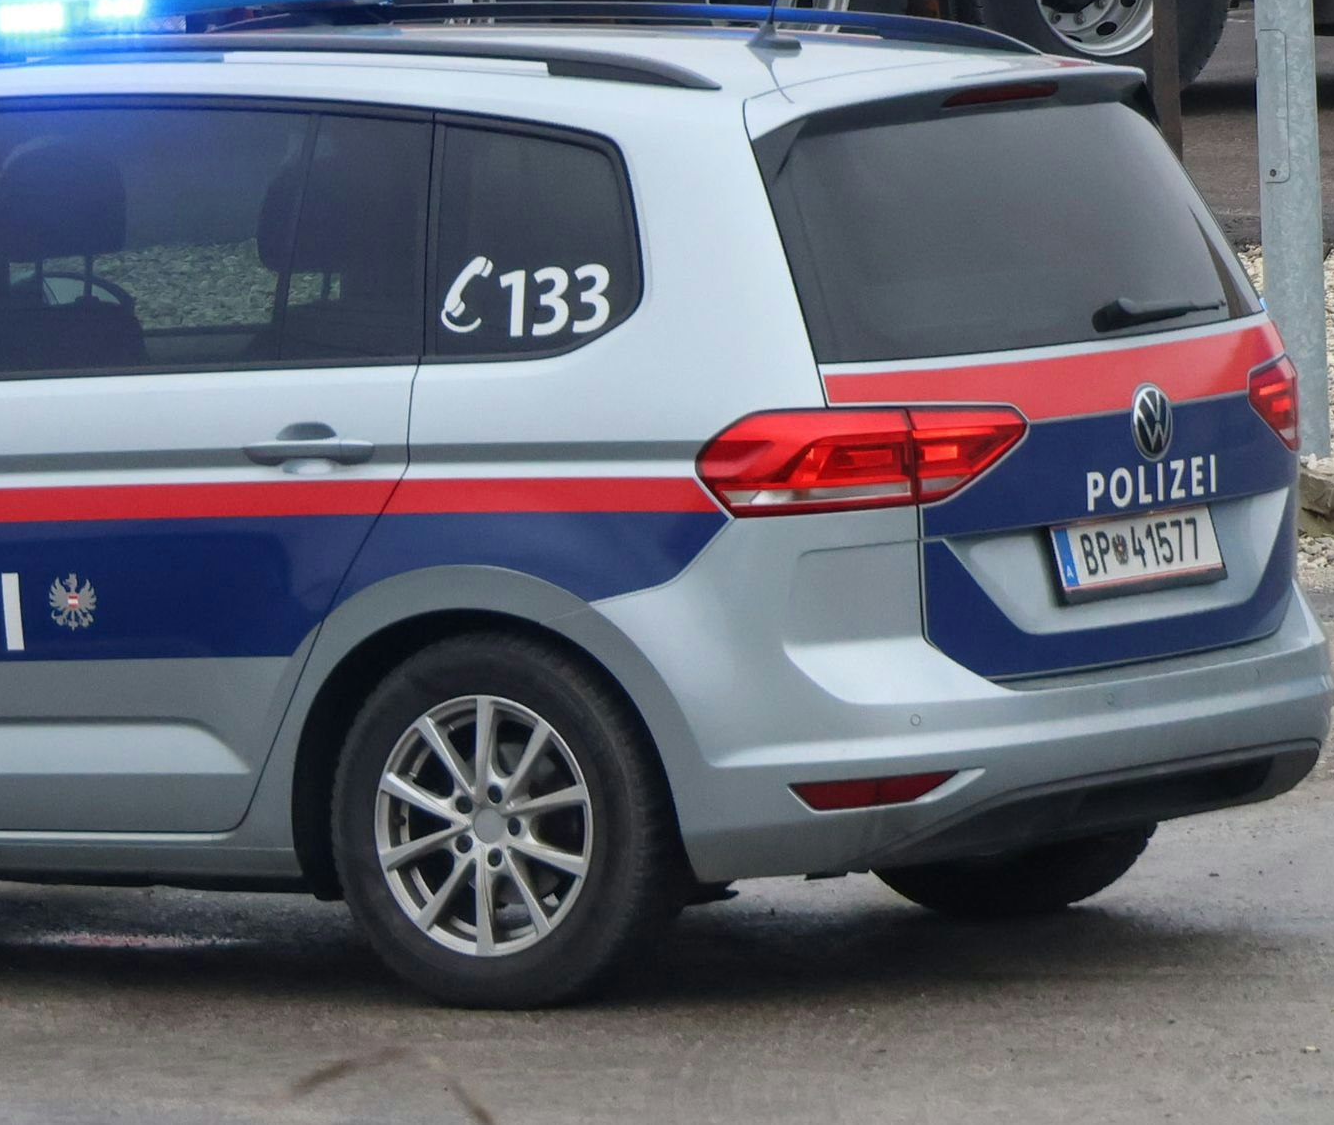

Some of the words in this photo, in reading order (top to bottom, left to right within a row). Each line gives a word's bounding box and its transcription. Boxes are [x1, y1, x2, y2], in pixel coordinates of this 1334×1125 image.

[499, 263, 610, 337] 133
[1086, 454, 1217, 511] POLIZEI
[1080, 530, 1110, 575] BP
[1131, 517, 1199, 568] 41577
